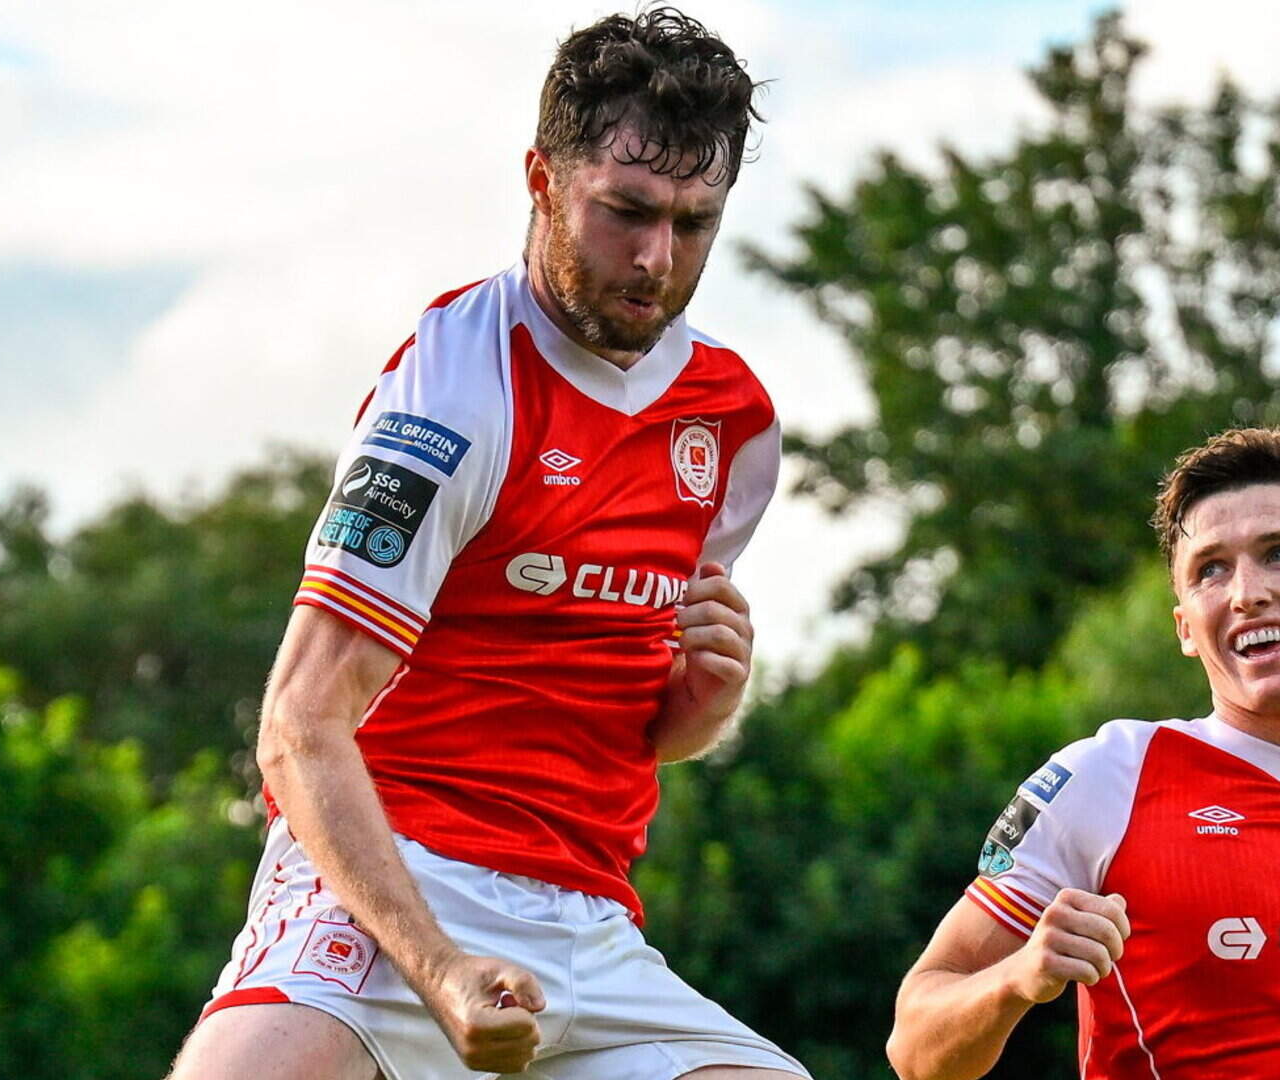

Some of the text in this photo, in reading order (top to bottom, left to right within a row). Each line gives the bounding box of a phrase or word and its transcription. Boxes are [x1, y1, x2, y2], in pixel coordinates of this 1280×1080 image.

[376, 418, 458, 456] BILL GRIFFIN
[413, 439, 451, 463] MOTORS
[371, 472, 401, 492] sse
[543, 473, 581, 486] umbro
[364, 485, 417, 519] Airtricity
[354, 512, 374, 531] OF
[1196, 823, 1239, 836] umbro
